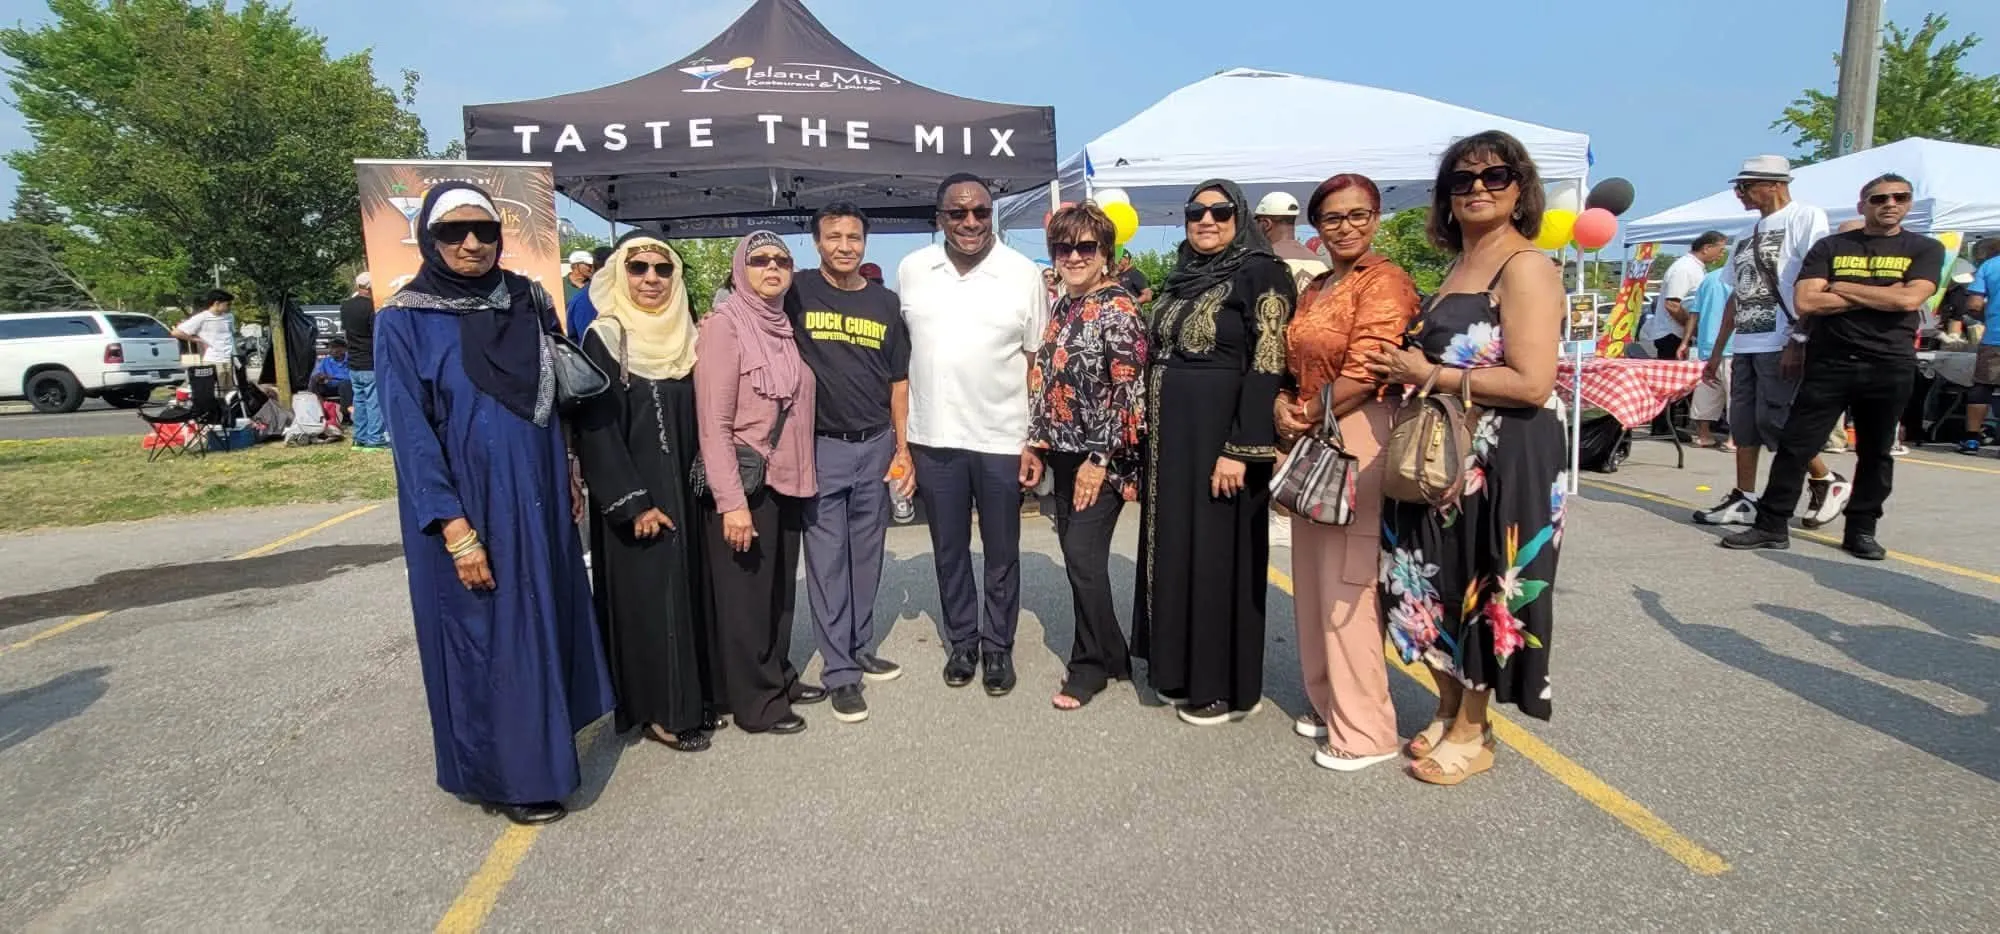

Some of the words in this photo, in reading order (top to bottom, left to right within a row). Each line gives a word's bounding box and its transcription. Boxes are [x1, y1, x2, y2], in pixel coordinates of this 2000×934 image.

[745, 65, 820, 81] Island
[832, 71, 882, 85] Mix
[746, 79, 815, 87] Restaurant
[513, 118, 714, 154] TASTE
[757, 114, 871, 150] THE
[914, 124, 1016, 157] MIX
[1833, 255, 1868, 269] DUCK
[1869, 256, 1913, 271] CURRY
[806, 312, 842, 330] DUCK
[845, 317, 887, 340] CURRY
